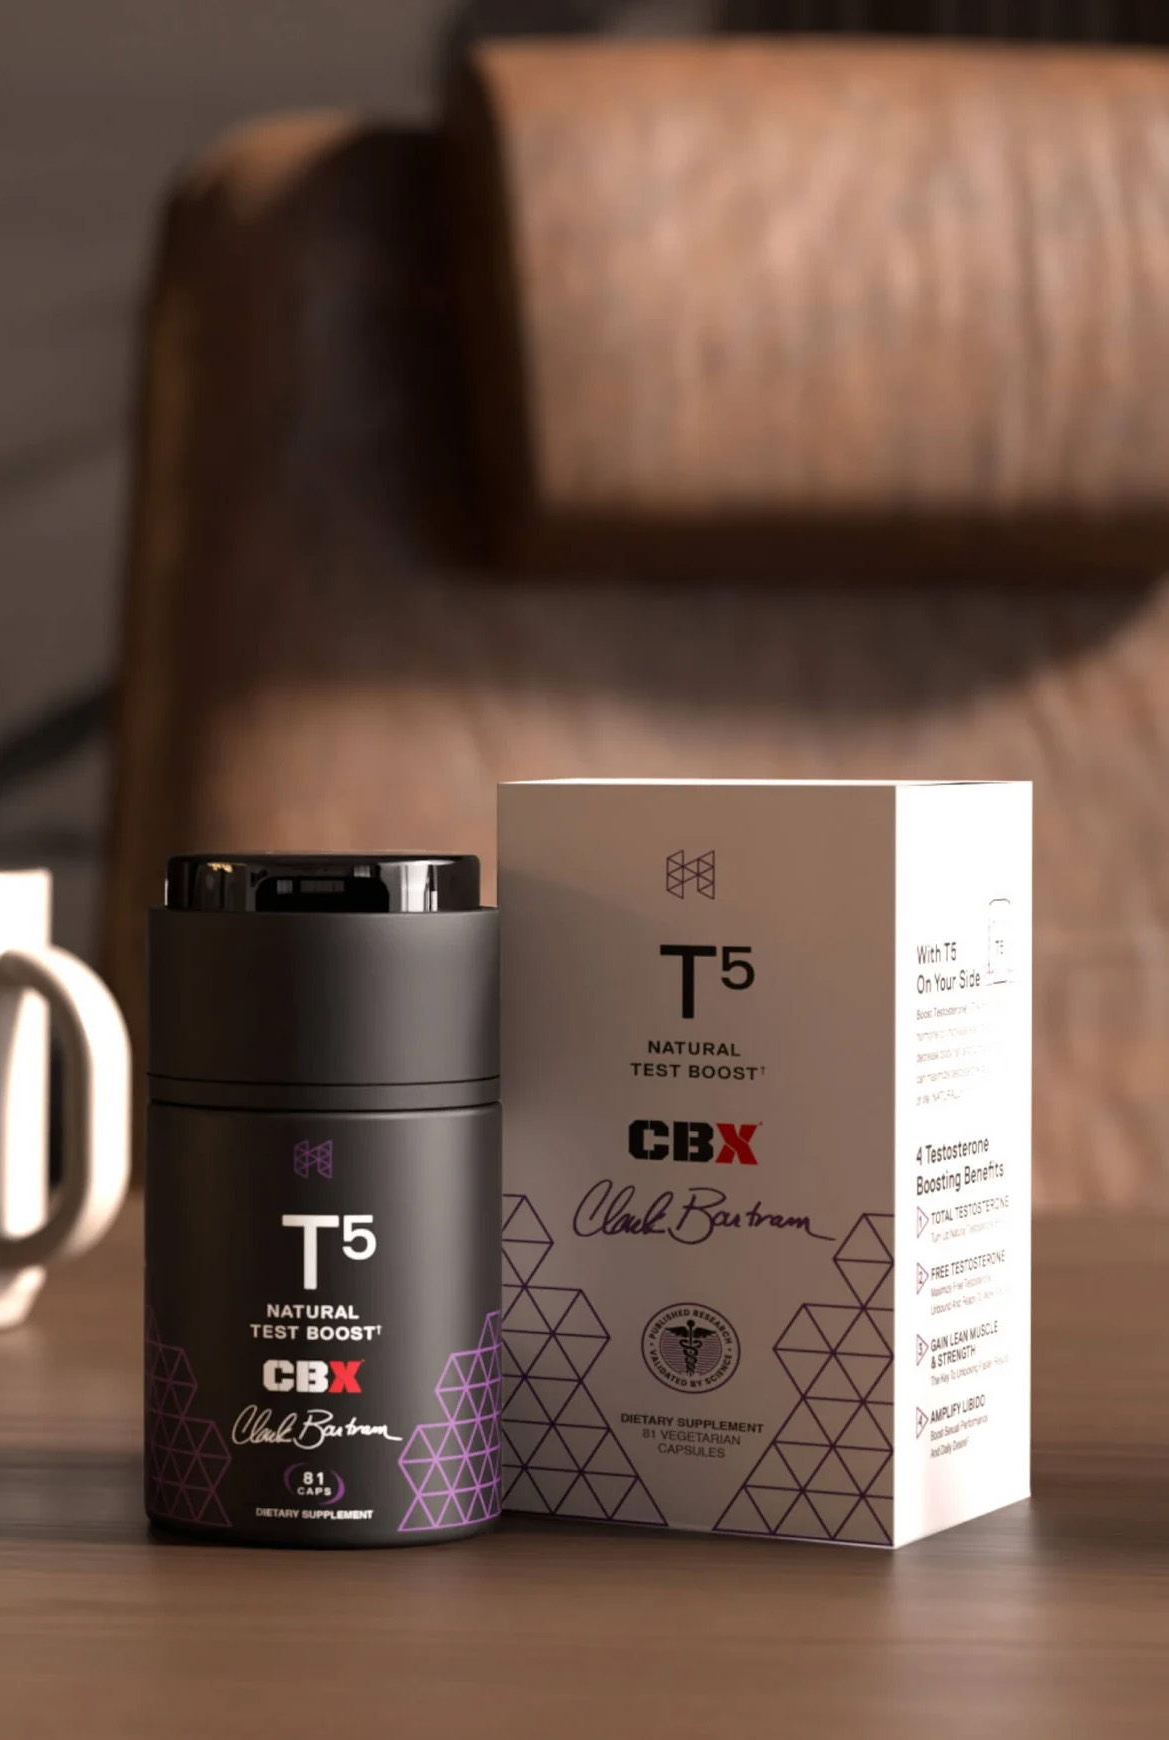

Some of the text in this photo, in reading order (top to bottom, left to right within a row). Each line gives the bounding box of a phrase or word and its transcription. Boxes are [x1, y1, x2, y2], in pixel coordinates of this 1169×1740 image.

[916, 941, 957, 965] With T5
[916, 969, 981, 995] On Your Side
[647, 1040, 742, 1057] NATURAL
[630, 1062, 682, 1078] TEST
[628, 1119, 760, 1165] CBX
[916, 1137, 990, 1166] 4 Testosterone
[916, 1160, 1005, 1196] Boosting Benefits
[931, 1208, 954, 1225] TOTAL
[955, 1195, 1010, 1220] TESTOSTERONE
[930, 1264, 950, 1281] FREE
[950, 1248, 1006, 1276] TESTOSTERONE
[266, 1303, 360, 1320] NATURAL
[249, 1323, 300, 1340] TEST
[648, 1308, 734, 1345] PUBLISHED RESEARCH
[930, 1335, 949, 1353] GAIN
[949, 1327, 969, 1347] LEAN
[969, 1319, 999, 1342] MUSCLE
[649, 1348, 734, 1388] VALIDATED BY SCIENCE
[930, 1355, 937, 1370] &
[937, 1343, 976, 1368] STRENGTH
[262, 1359, 364, 1394] CBX
[930, 1400, 962, 1424] AMPLIFY
[962, 1393, 986, 1413] LIBIDO
[620, 1412, 764, 1434] DIETARY SUPPLEMENT
[642, 1428, 742, 1446] 81 VEGETARIAN
[657, 1442, 726, 1459] CAPSULES
[296, 1486, 332, 1496] CAPS
[303, 1471, 325, 1486] 81
[255, 1508, 374, 1520] DIETARY SUPPLEMENT
